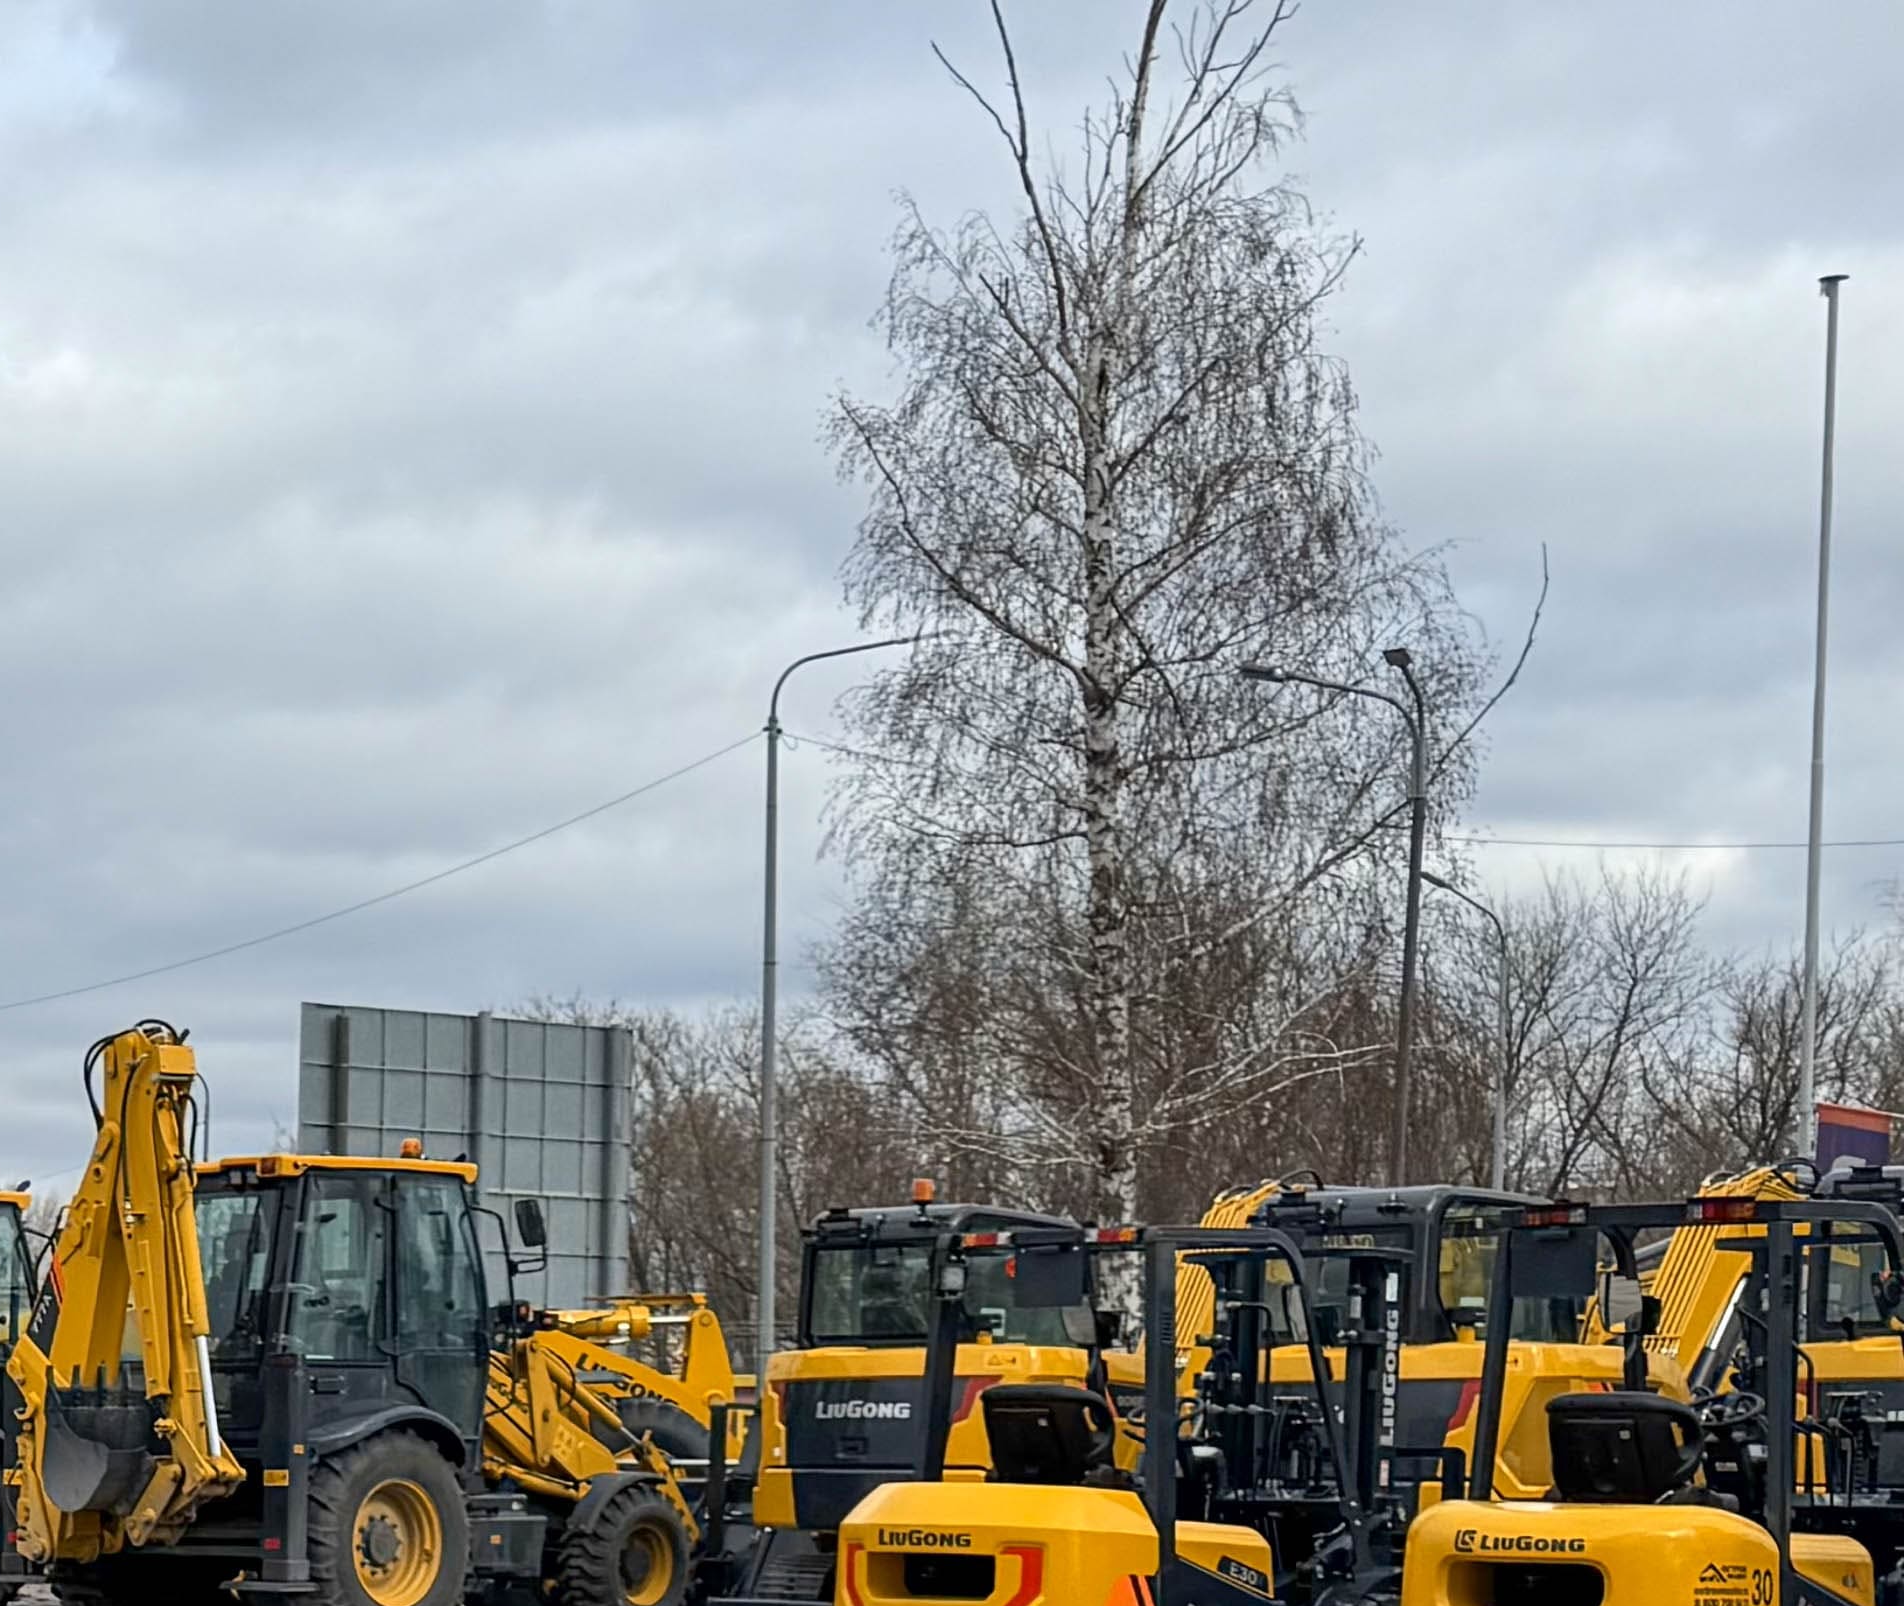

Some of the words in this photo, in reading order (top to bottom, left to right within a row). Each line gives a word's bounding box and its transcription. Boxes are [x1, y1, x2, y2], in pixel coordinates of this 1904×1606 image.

[1379, 1309, 1399, 1447] LIUGONG
[1230, 1562, 1258, 1585] E30
[1752, 1569, 1773, 1606] 30
